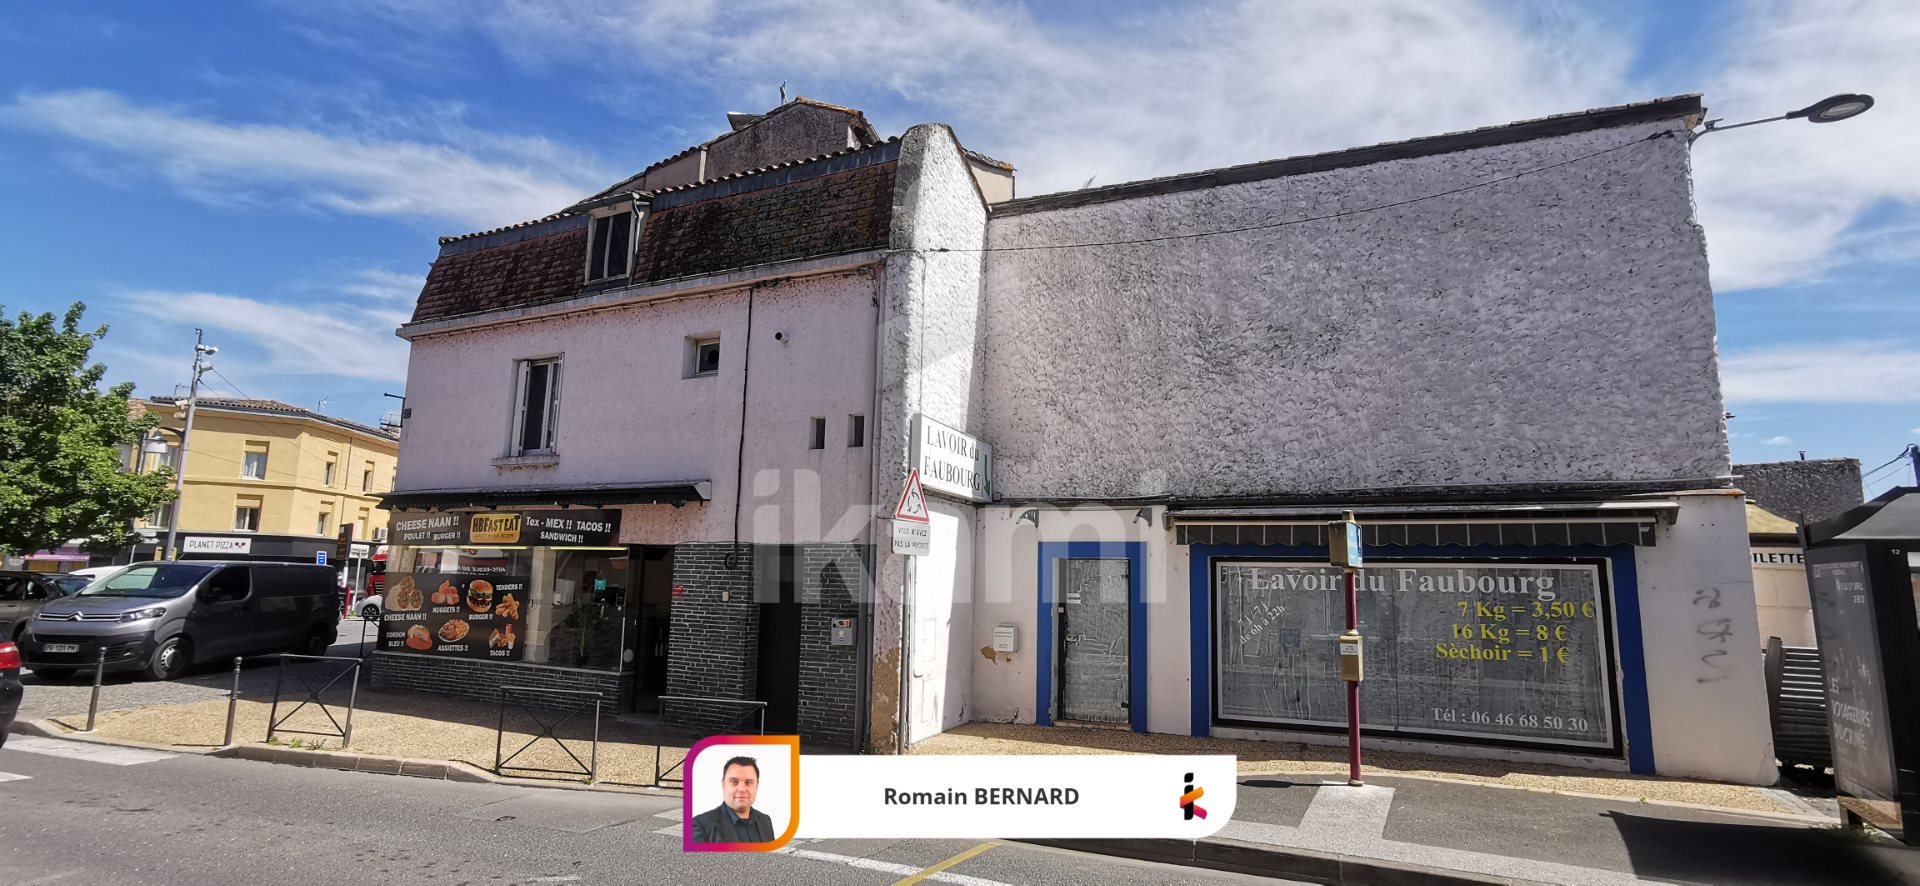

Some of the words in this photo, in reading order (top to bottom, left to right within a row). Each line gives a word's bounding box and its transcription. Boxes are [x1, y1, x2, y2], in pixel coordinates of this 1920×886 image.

[927, 426, 967, 457] LAVOIR
[970, 441, 980, 461] du
[924, 456, 980, 490] FAUBOURG
[396, 519, 428, 531] CHEESE
[428, 517, 452, 528] NAAN
[526, 516, 540, 526] Tex
[546, 518, 564, 529] MEX
[576, 521, 603, 532] TACOS
[404, 532, 426, 541] POULET
[434, 532, 455, 541] BURGER
[540, 531, 577, 542] SANDWICH
[1249, 568, 1342, 591] Lavoir
[1354, 568, 1386, 592] du
[1396, 568, 1556, 601] Faubourg
[1457, 602, 1468, 617] 7
[1476, 602, 1506, 621] Kg
[1531, 602, 1575, 620] 3,50
[1581, 602, 1594, 617] €
[1240, 633, 1252, 644] de
[1250, 622, 1263, 635] 6h
[1267, 605, 1285, 620] 22h
[1451, 623, 1473, 639] 16
[1480, 624, 1510, 644] Kg
[1536, 624, 1548, 641] 8
[1554, 625, 1567, 641] €
[1436, 643, 1511, 661] Sèchoir
[1539, 647, 1548, 662] 1
[1557, 647, 1570, 663] €
[1431, 708, 1456, 722] Tél
[1471, 711, 1490, 724] 06
[1495, 712, 1514, 726] 46
[1518, 714, 1538, 728] 68
[1544, 716, 1563, 730] 50
[1568, 718, 1588, 732] 30
